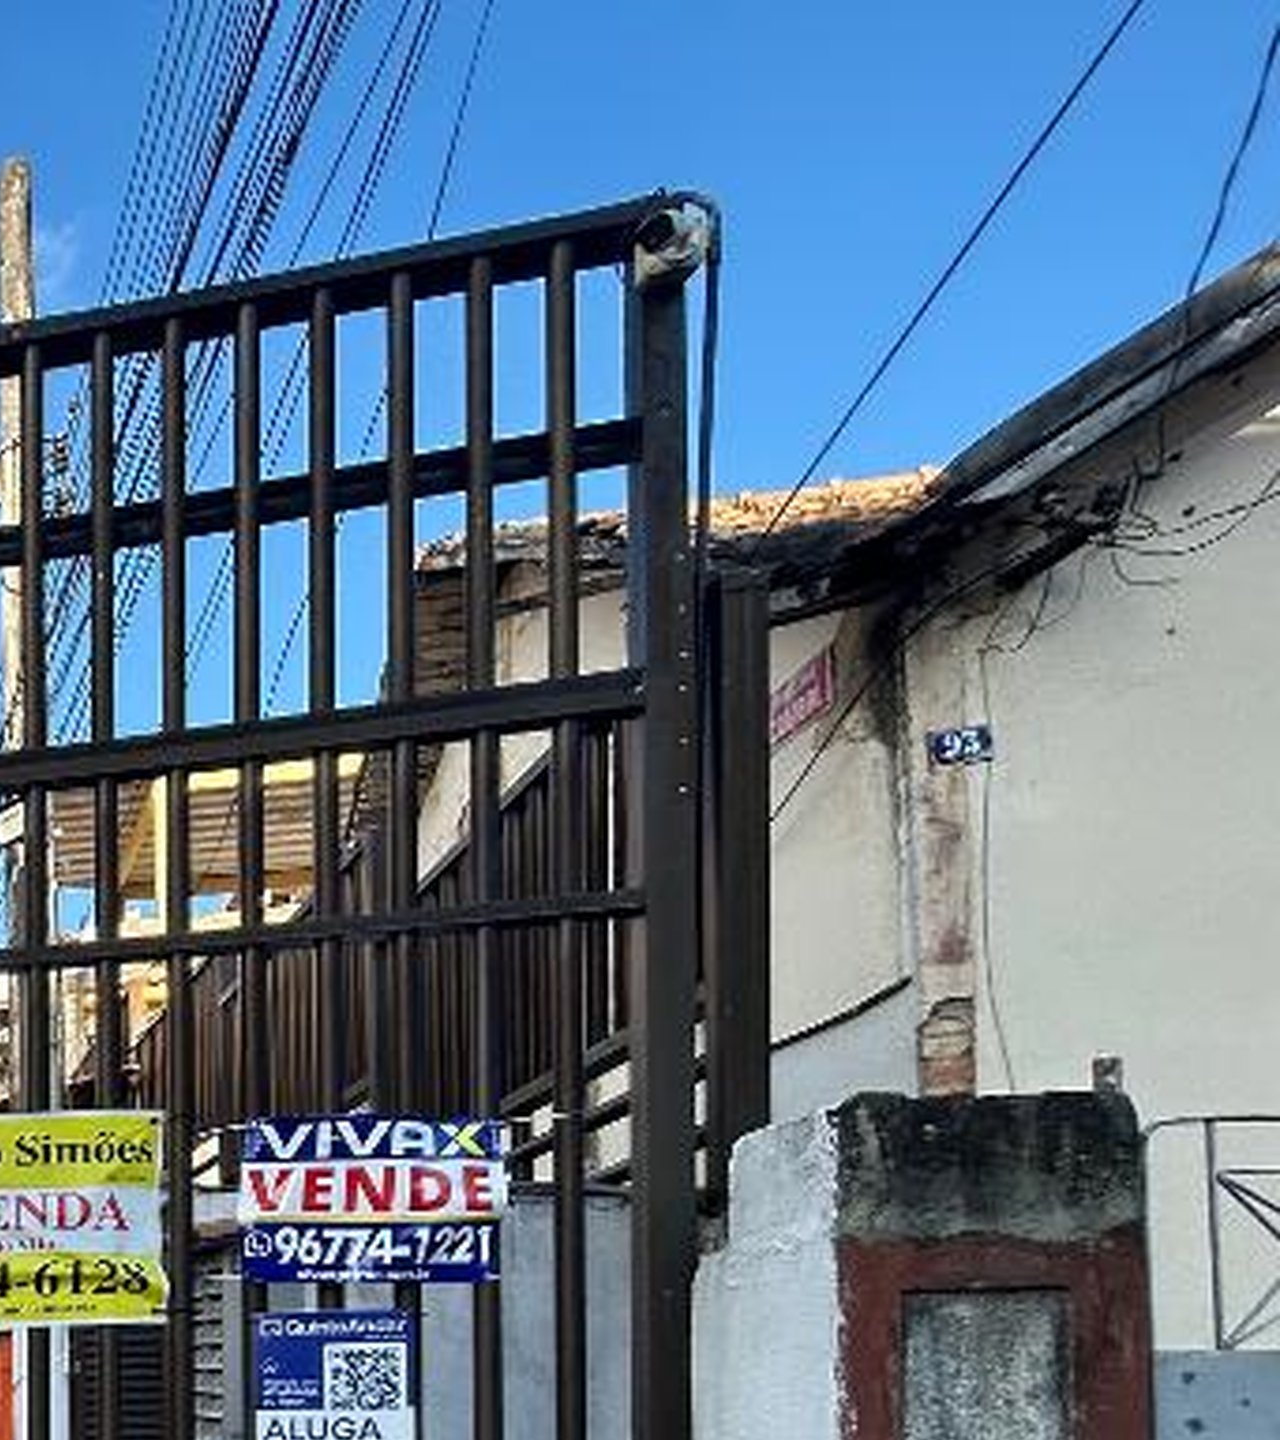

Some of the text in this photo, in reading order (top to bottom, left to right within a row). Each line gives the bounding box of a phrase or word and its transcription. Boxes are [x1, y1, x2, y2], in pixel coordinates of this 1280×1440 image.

[15, 1131, 153, 1168] Simões
[260, 1120, 486, 1159] VIVAX
[248, 1166, 493, 1212] VENDE
[275, 1226, 494, 1264] 96774-1221
[263, 1416, 382, 1440] ALUGA
